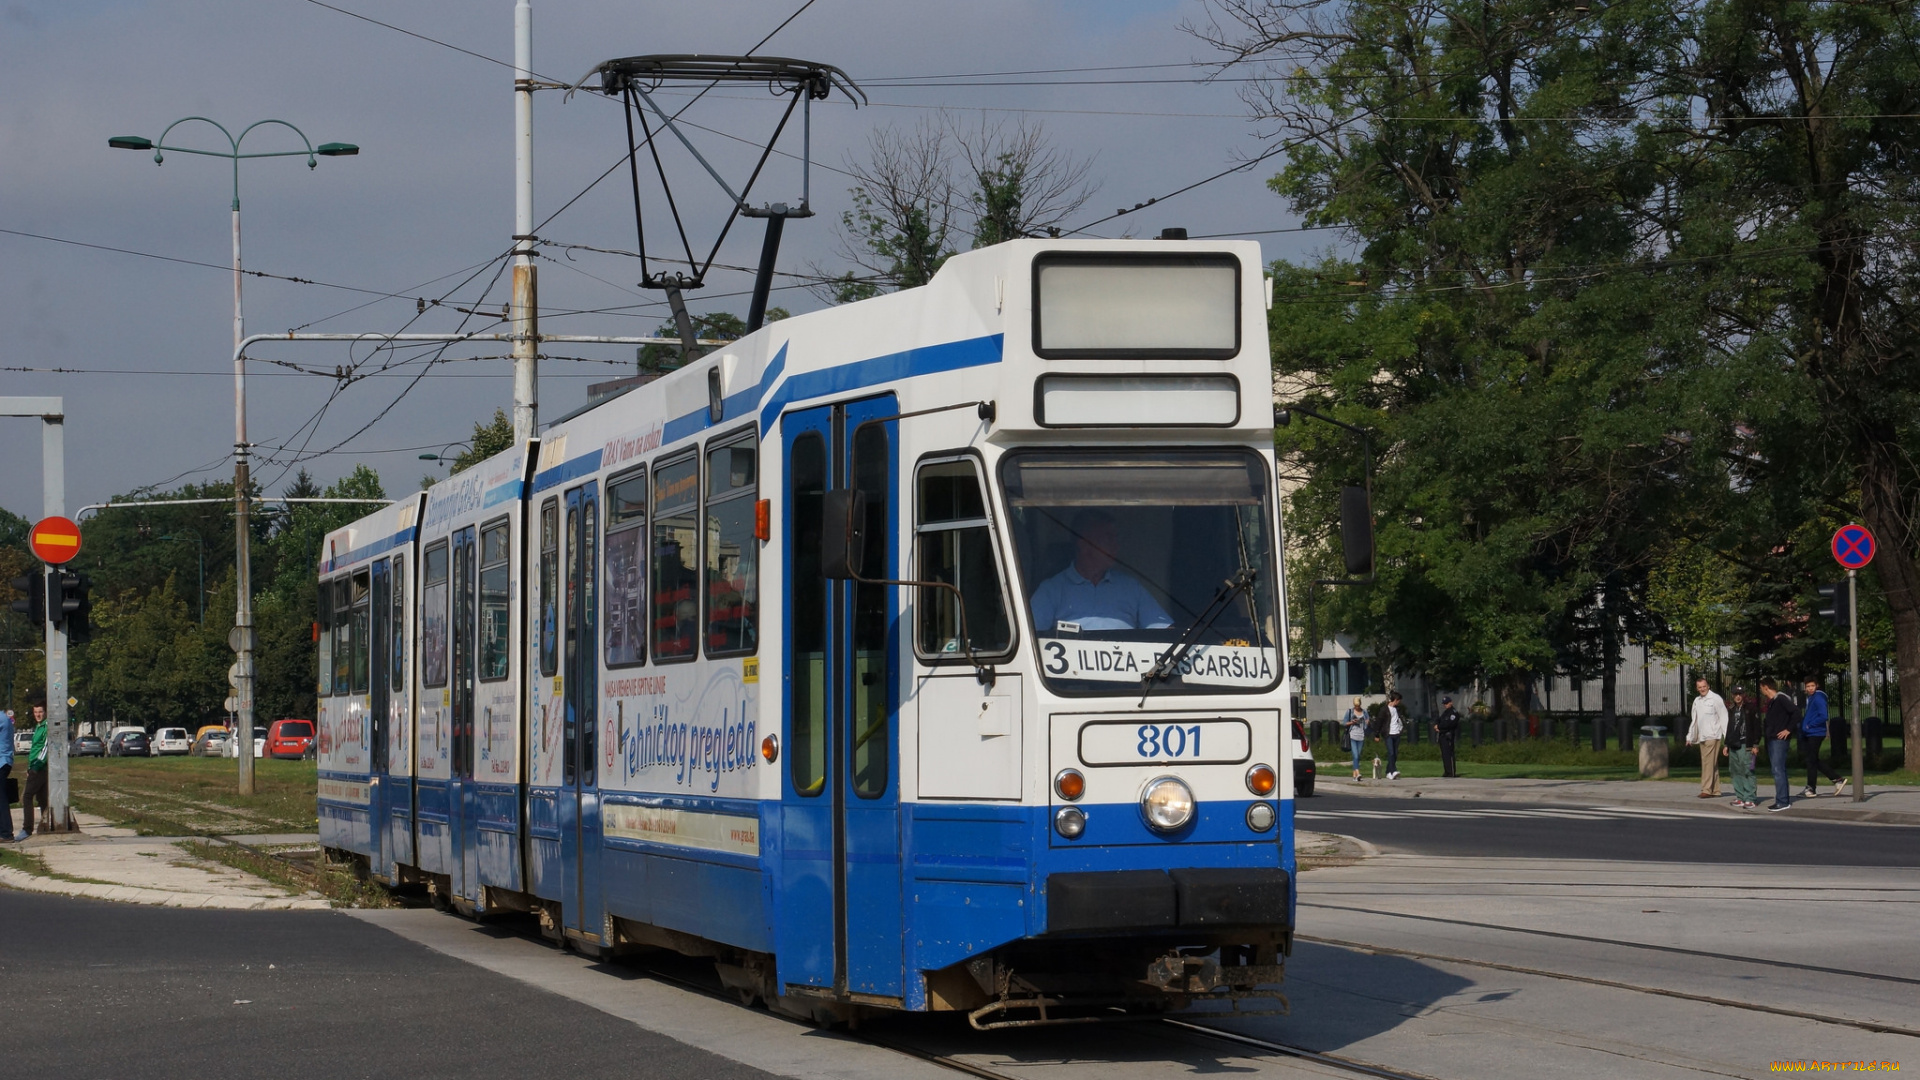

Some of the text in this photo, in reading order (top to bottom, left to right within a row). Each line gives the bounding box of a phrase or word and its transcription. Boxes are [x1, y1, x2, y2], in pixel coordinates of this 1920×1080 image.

[1044, 641, 1069, 675] 3
[1078, 646, 1138, 673] ILIDŽA
[621, 704, 687, 786] Tehničkog
[688, 700, 756, 793] pregleda
[1137, 725, 1201, 758] 801
